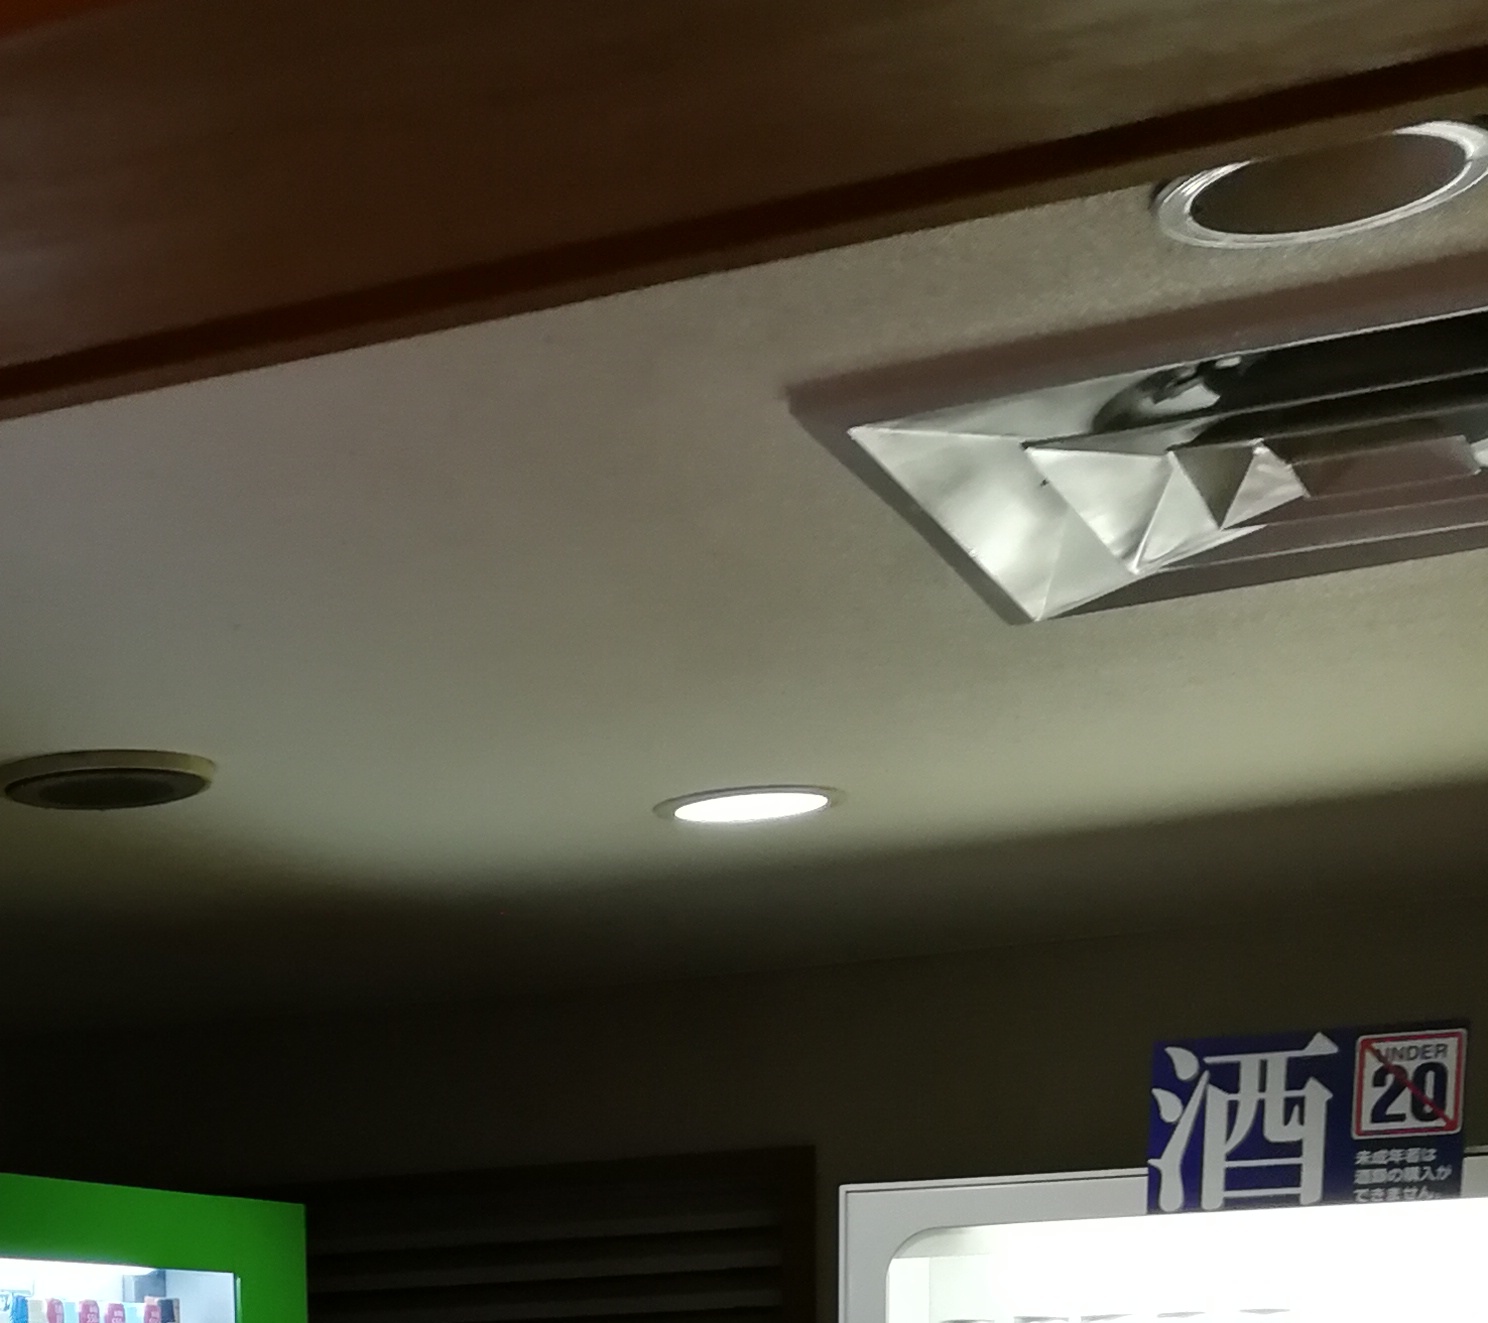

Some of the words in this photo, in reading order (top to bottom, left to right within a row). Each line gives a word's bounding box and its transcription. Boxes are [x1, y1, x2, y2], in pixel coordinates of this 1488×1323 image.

[1382, 1043, 1448, 1061] UNDER
[1148, 1032, 1339, 1211] 酒
[1371, 1062, 1448, 1124] 20
